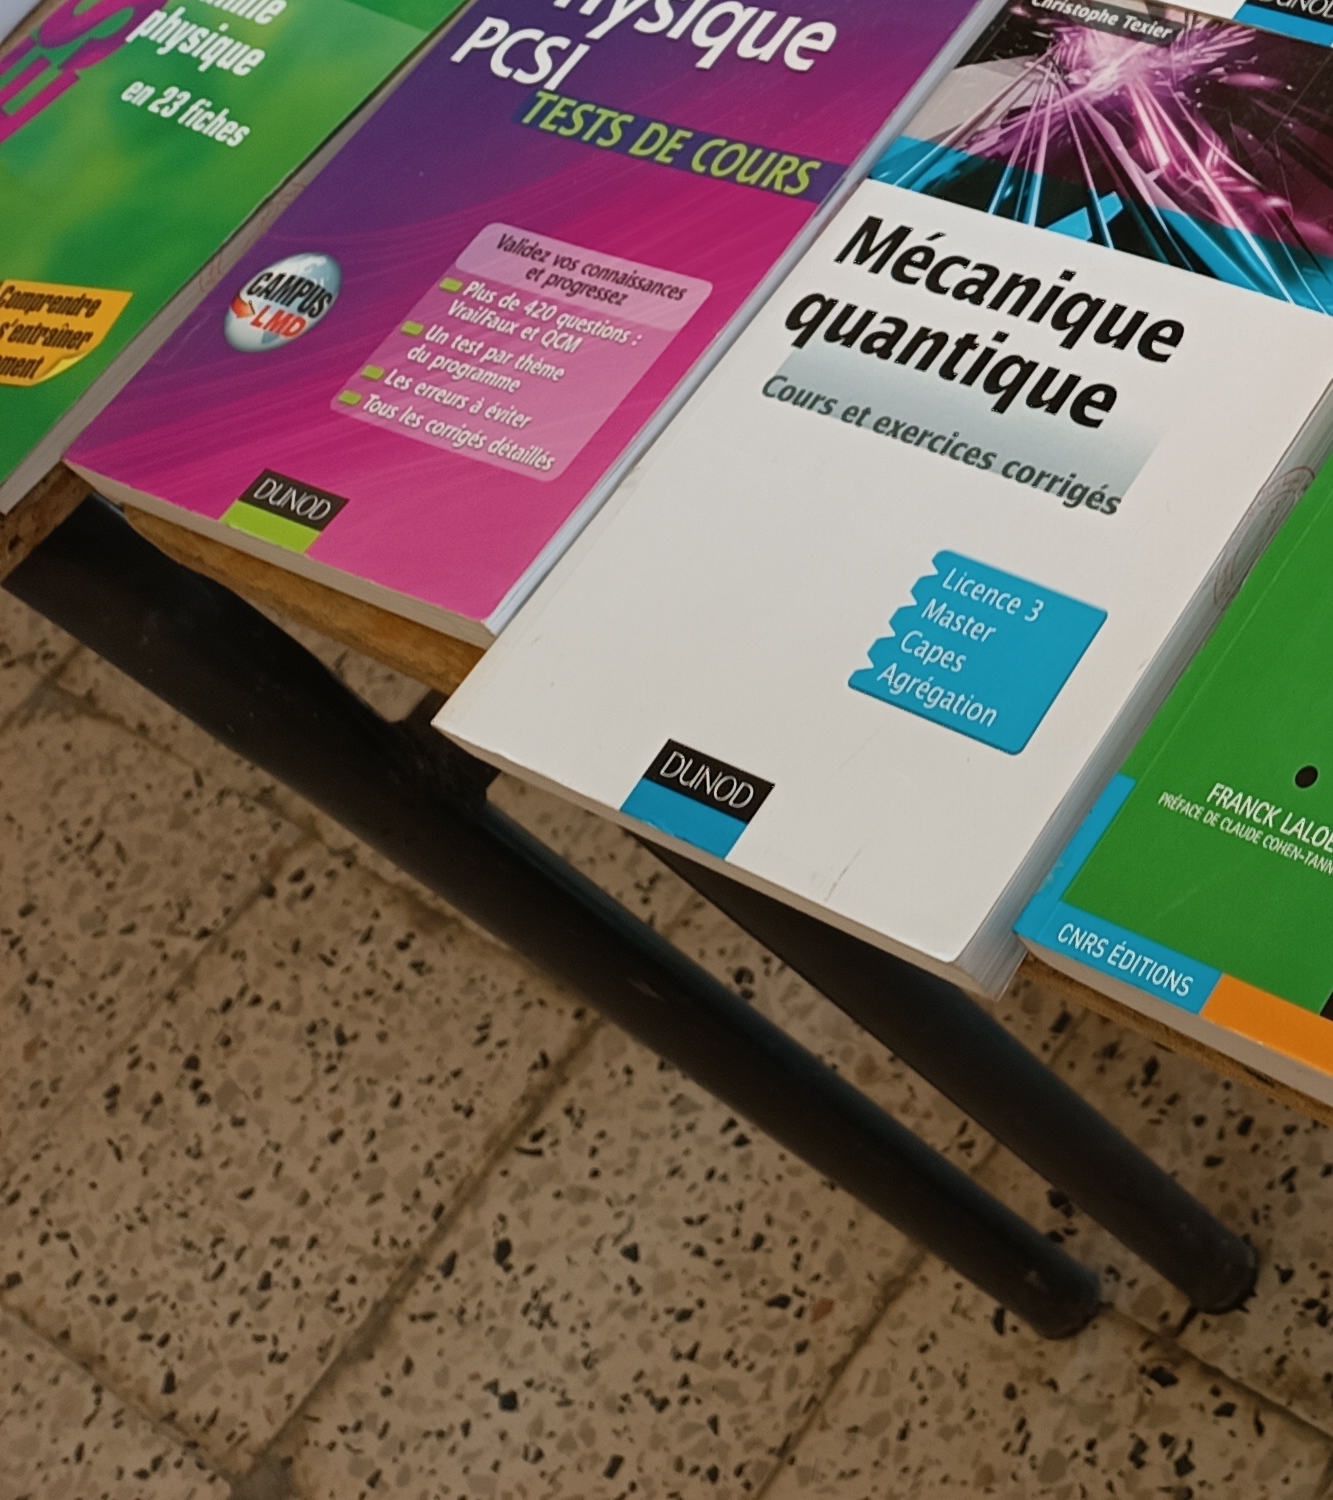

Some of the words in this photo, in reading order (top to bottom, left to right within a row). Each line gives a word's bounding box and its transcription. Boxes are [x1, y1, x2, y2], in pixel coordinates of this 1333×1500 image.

[126, 3, 266, 78] physique
[451, 15, 591, 94] PCSI
[520, 90, 634, 152] TESTS
[627, 121, 692, 167] DE
[689, 133, 823, 197] COURS
[833, 214, 1187, 365] Mécanique
[783, 284, 1120, 431] quantique
[941, 566, 1023, 618] Licence
[1026, 597, 1046, 624] 3
[875, 659, 1000, 729] Agrégation
[1206, 782, 1282, 828] FRANCK
[1056, 922, 1111, 961] CNRS
[1106, 938, 1195, 999] ÉDITIONS
